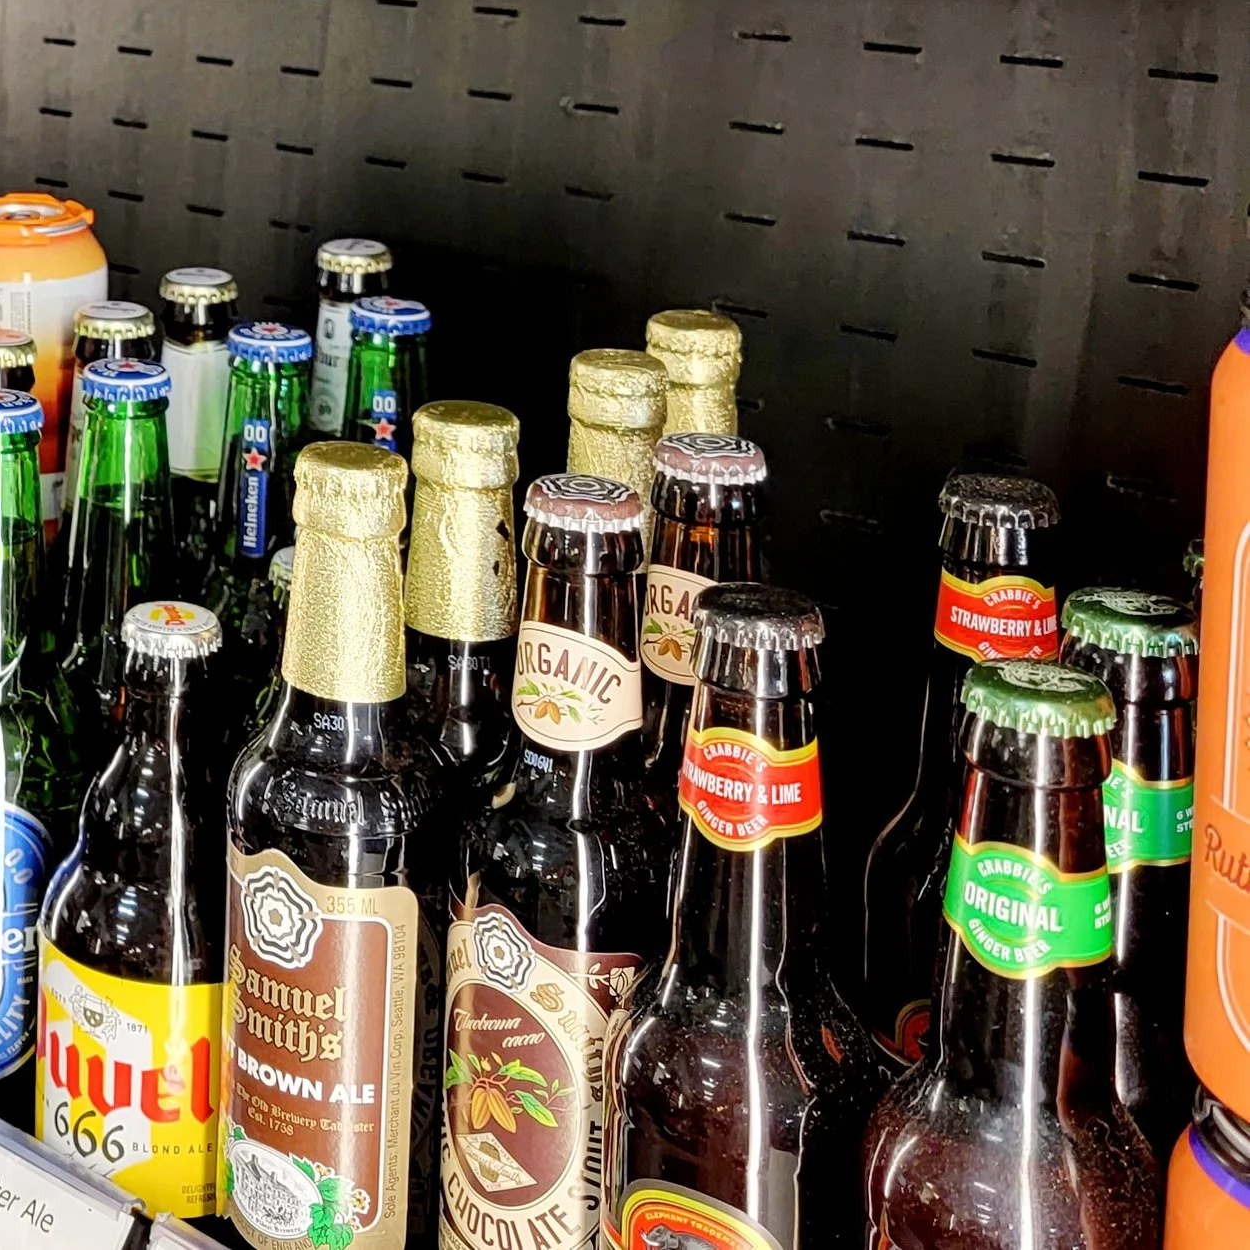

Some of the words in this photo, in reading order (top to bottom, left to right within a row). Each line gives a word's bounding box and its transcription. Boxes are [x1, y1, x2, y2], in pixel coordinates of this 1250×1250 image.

[243, 476, 259, 549] Heineken
[643, 583, 694, 620] ORGA
[982, 588, 1041, 611] CRABBIE'S
[950, 605, 1032, 638] STRAWBERRY
[1034, 620, 1043, 636] &
[516, 642, 622, 707] ORGANIC
[702, 741, 768, 773] CRABBIE'S
[756, 784, 768, 804] &
[771, 781, 802, 805] LIME
[696, 799, 736, 836] GINGER
[736, 814, 769, 837] BEER
[4, 848, 34, 886] 0.0
[976, 859, 1054, 896] CRABBIE'S
[326, 894, 356, 915] 355
[360, 897, 379, 916] ML
[963, 880, 1064, 932] ORIGINAL
[396, 923, 407, 960] 98104
[968, 917, 1012, 963] GINGER
[1014, 937, 1053, 964] BEER
[228, 942, 348, 1022] Samuel
[394, 963, 405, 982] WA
[393, 984, 406, 1024] Seattle,
[453, 1006, 522, 1034] Theobroma
[229, 983, 344, 1063] Smith's
[391, 1026, 404, 1057] Corp,
[501, 1031, 546, 1050] cacao
[48, 1029, 216, 1125] uvel
[236, 1049, 324, 1103] BROWN
[327, 1081, 376, 1104] ALE
[391, 1058, 402, 1080] Vin
[390, 1080, 401, 1097] du
[387, 1099, 401, 1150] Merchant
[132, 1142, 181, 1156] BLOND
[188, 1142, 214, 1154] ALE
[568, 1117, 604, 1212] STOUT
[385, 1150, 401, 1197] Agents:
[20, 1198, 55, 1234] Ale
[384, 1197, 397, 1220] Sole
